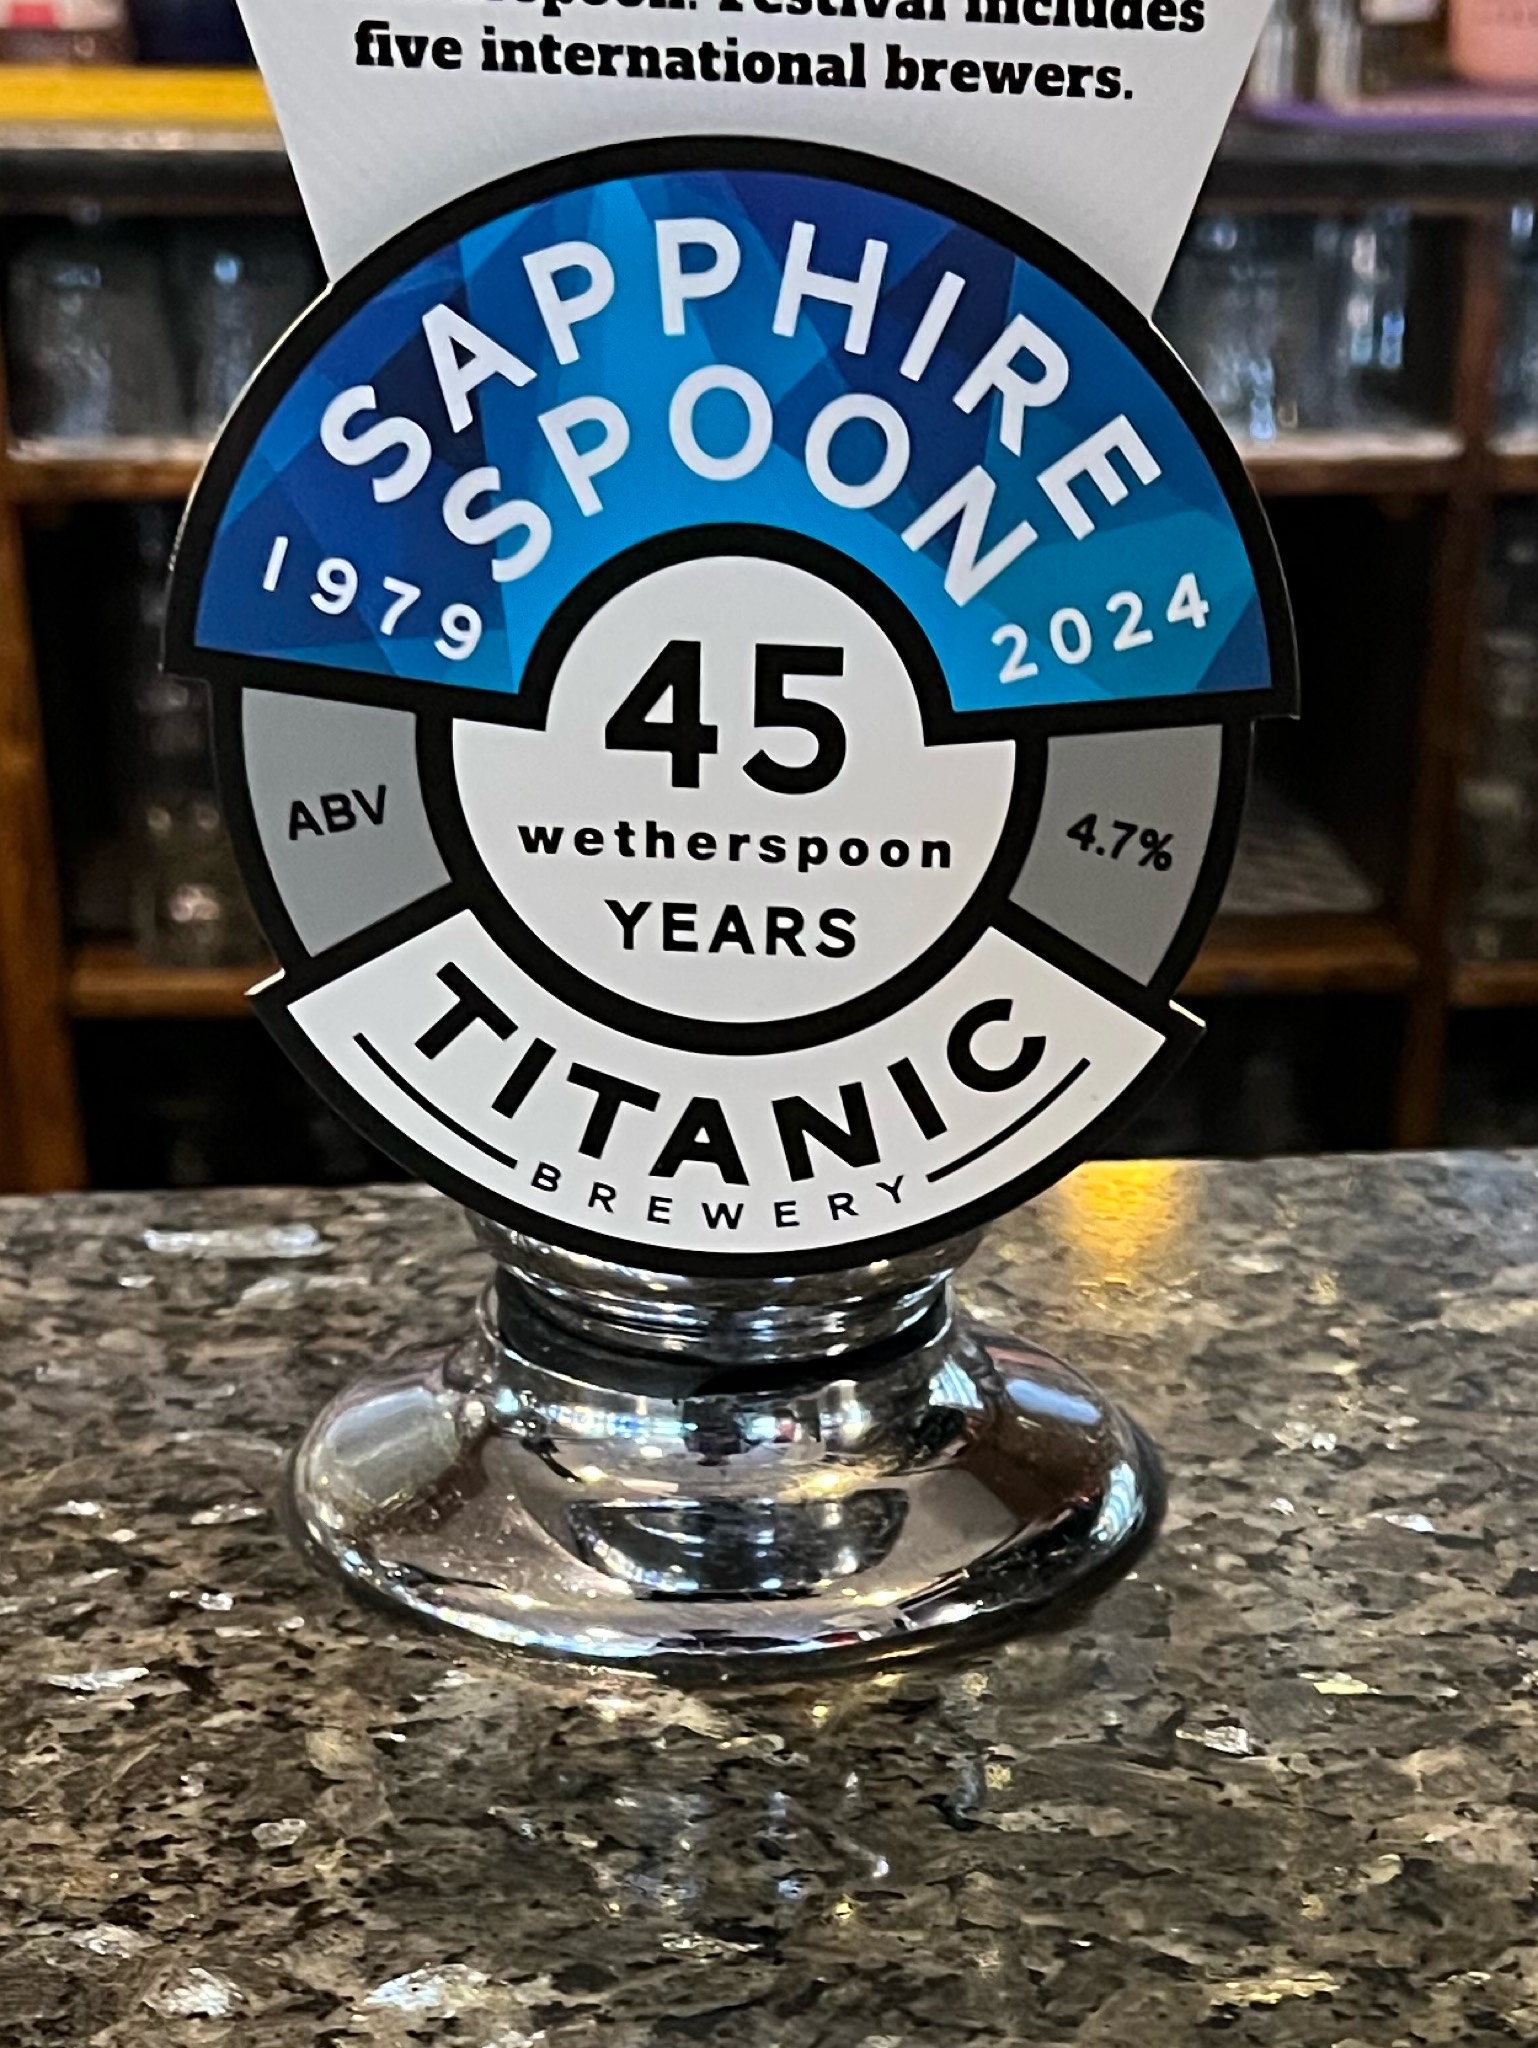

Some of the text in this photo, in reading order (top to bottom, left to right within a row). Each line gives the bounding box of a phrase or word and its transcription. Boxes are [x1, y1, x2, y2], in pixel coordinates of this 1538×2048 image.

[354, 20, 1133, 100] five international brewers.
[320, 218, 1162, 540] SAPPHIRE
[443, 365, 1038, 606] SPOON
[263, 536, 482, 661] 1979
[992, 572, 1209, 683] 2024
[604, 639, 847, 795] 45
[288, 784, 387, 841] ABV
[517, 820, 951, 873] wetherspoon
[1066, 813, 1174, 872] 4.7%
[604, 899, 856, 959] YEARS
[414, 961, 1047, 1187] TITANIC
[531, 1161, 904, 1230] BREWERY
